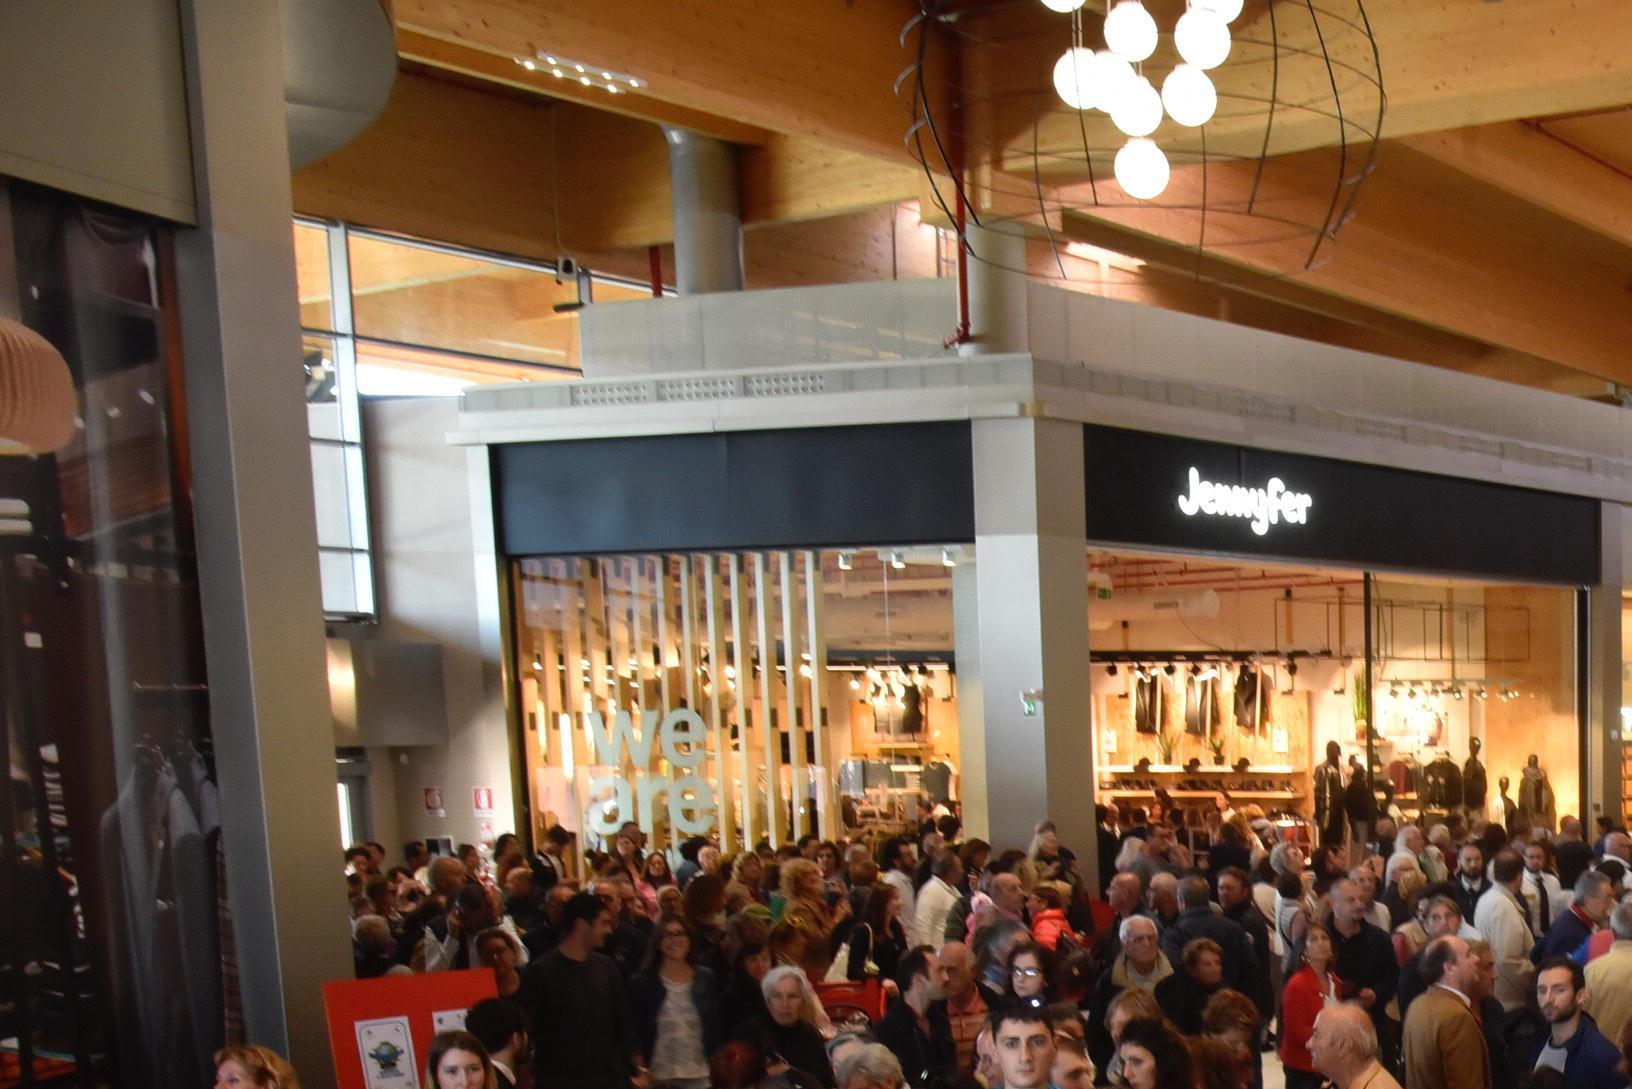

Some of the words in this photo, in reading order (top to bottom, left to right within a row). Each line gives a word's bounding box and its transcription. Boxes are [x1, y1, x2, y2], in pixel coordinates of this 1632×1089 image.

[1178, 466, 1313, 536] Jennyfer
[588, 708, 707, 768] we
[588, 776, 718, 836] are
